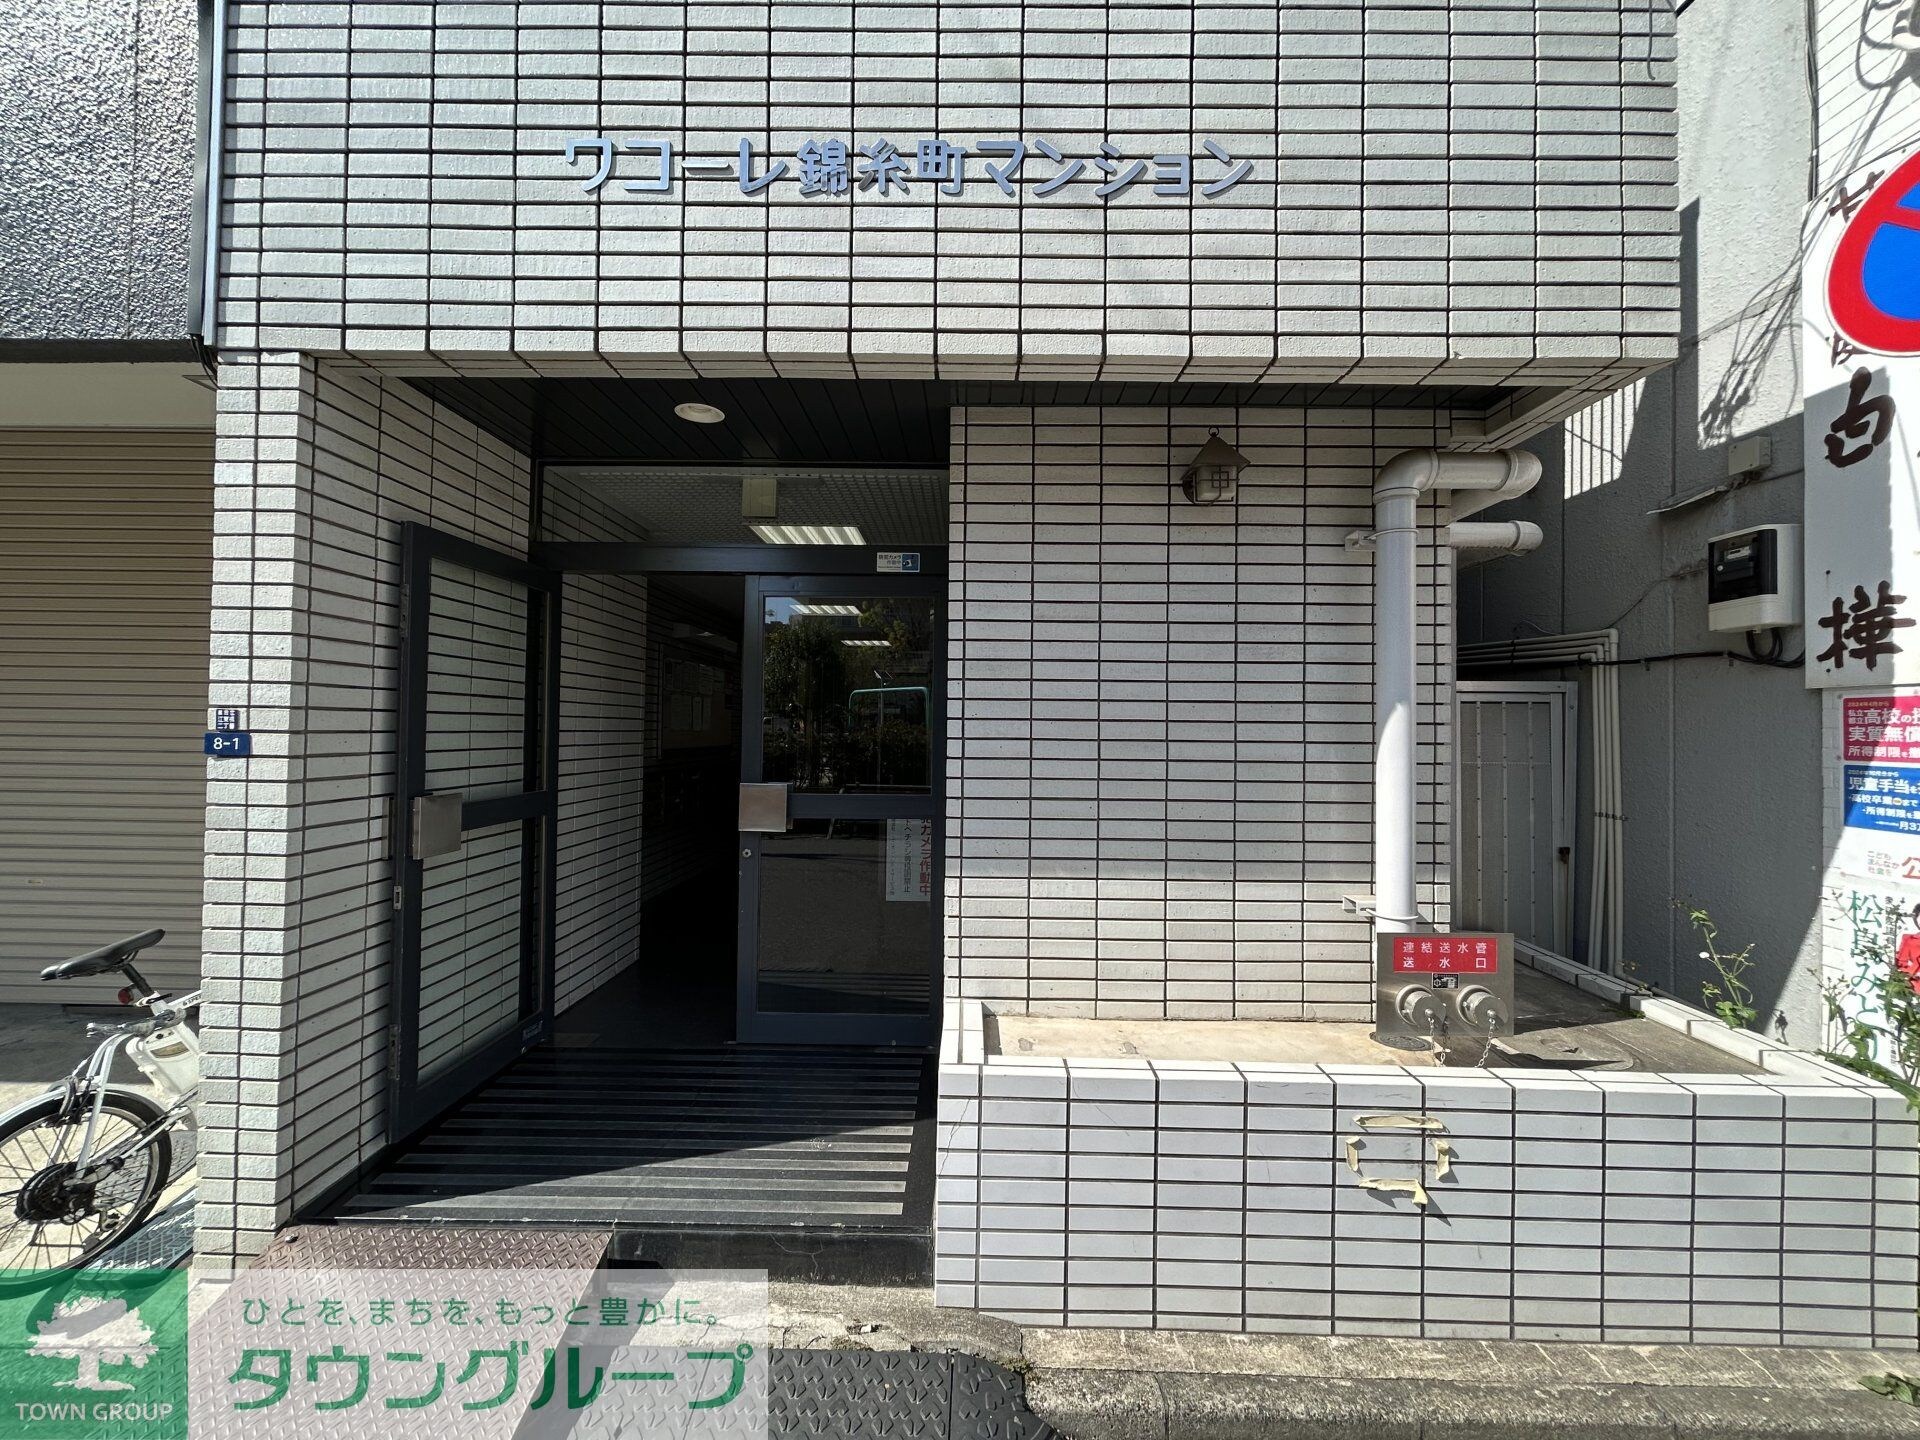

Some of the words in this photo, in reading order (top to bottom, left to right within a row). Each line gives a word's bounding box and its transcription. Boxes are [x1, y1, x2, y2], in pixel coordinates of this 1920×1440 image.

[565, 137, 1253, 197] ワコーレ錦糸町マンション
[213, 737, 240, 750] 8-1
[1849, 777, 1920, 795] 児童手当を
[1403, 942, 1487, 954] 連結送水管
[1403, 957, 1487, 968] 送水口
